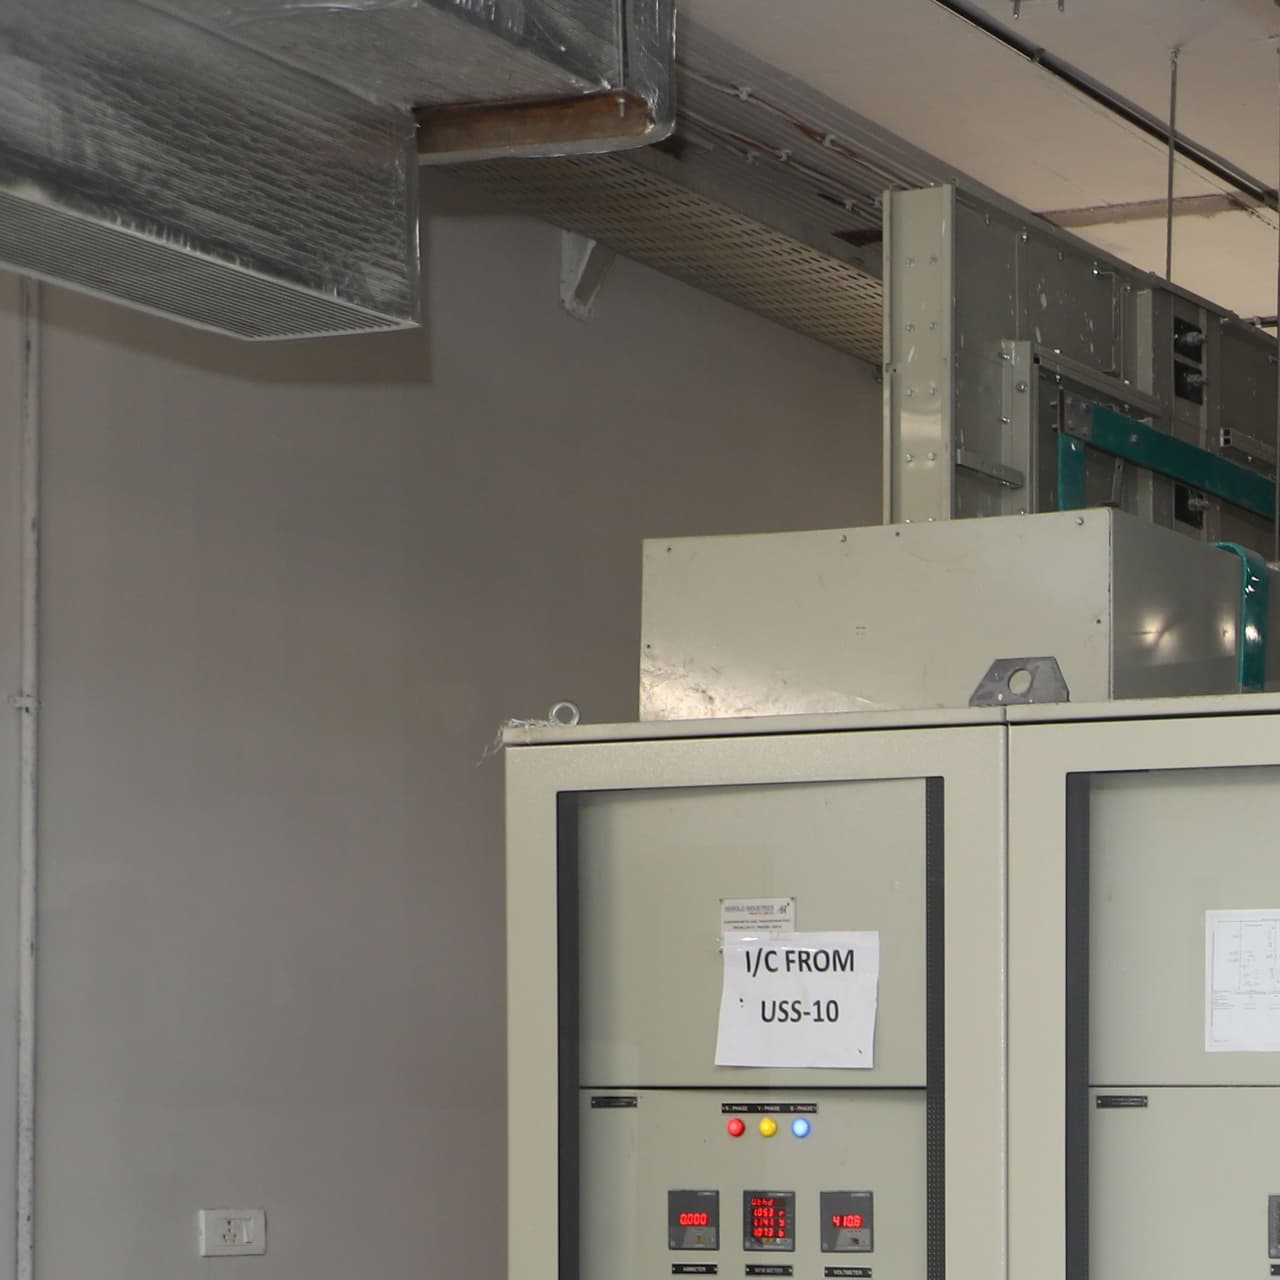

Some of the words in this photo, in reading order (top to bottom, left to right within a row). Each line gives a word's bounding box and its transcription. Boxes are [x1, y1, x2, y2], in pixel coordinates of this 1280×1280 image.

[745, 948, 778, 977] I/C
[785, 949, 854, 972] FROM
[761, 1000, 839, 1022] USS-10
